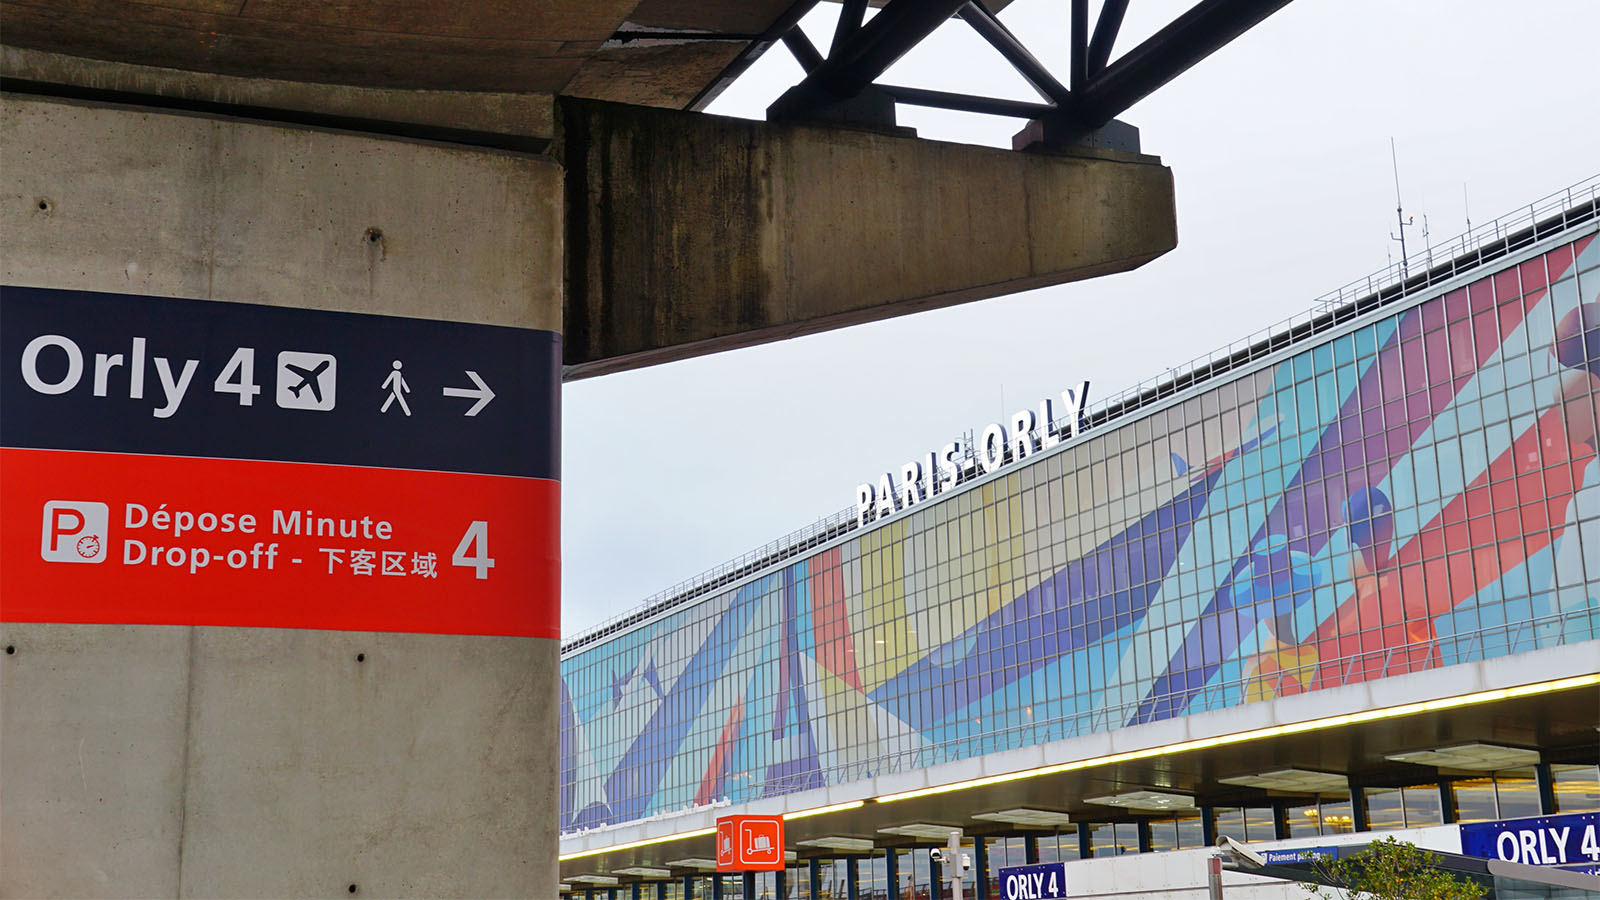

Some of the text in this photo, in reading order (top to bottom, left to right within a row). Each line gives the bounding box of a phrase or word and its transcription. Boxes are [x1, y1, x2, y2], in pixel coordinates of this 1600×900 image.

[20, 334, 261, 419] Orly 4
[124, 503, 393, 540] Dépose Minute
[122, 539, 279, 574] Drop-off
[318, 548, 438, 578] 下客区域
[451, 520, 496, 580] 4
[1269, 852, 1297, 862] Paiement
[1497, 824, 1600, 865] ORLY 4
[1006, 871, 1059, 900] ORLY 4
